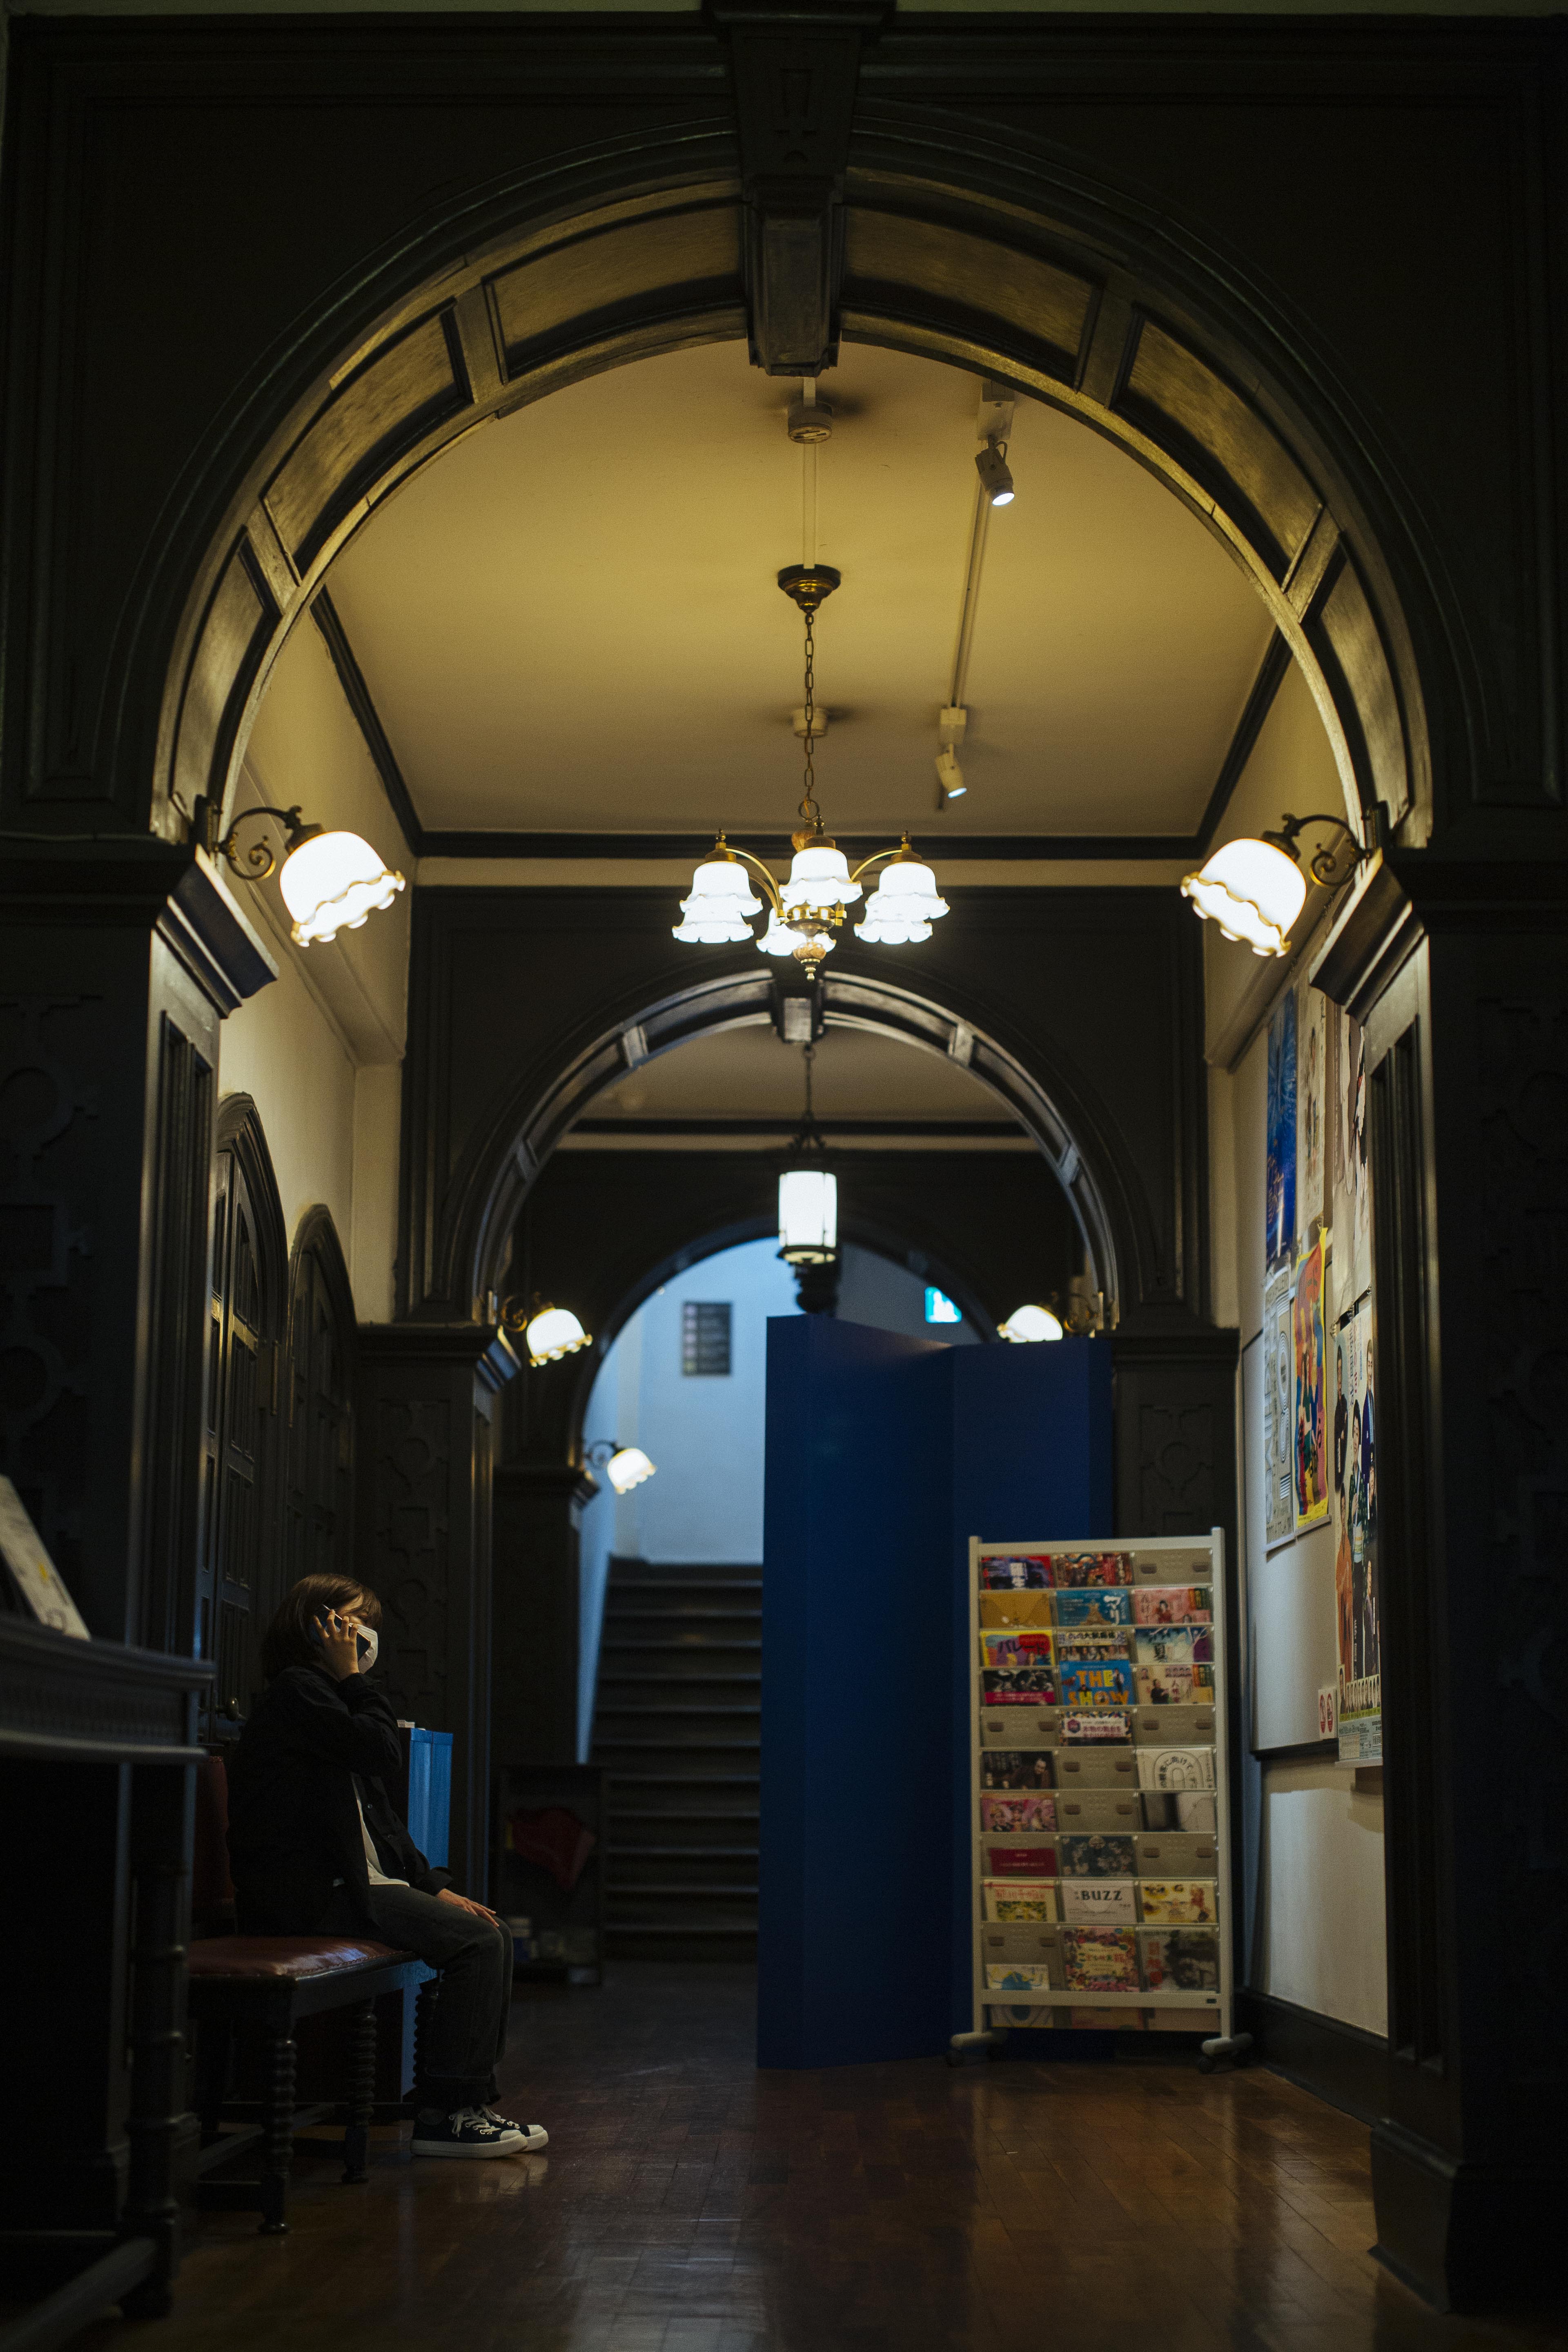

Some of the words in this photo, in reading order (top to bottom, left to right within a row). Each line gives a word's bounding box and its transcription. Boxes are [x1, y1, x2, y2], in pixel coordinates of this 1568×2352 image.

[1076, 1670, 1114, 1687] THE
[1068, 1690, 1129, 1706] SHOW
[1080, 1890, 1123, 1901] BUZZ
